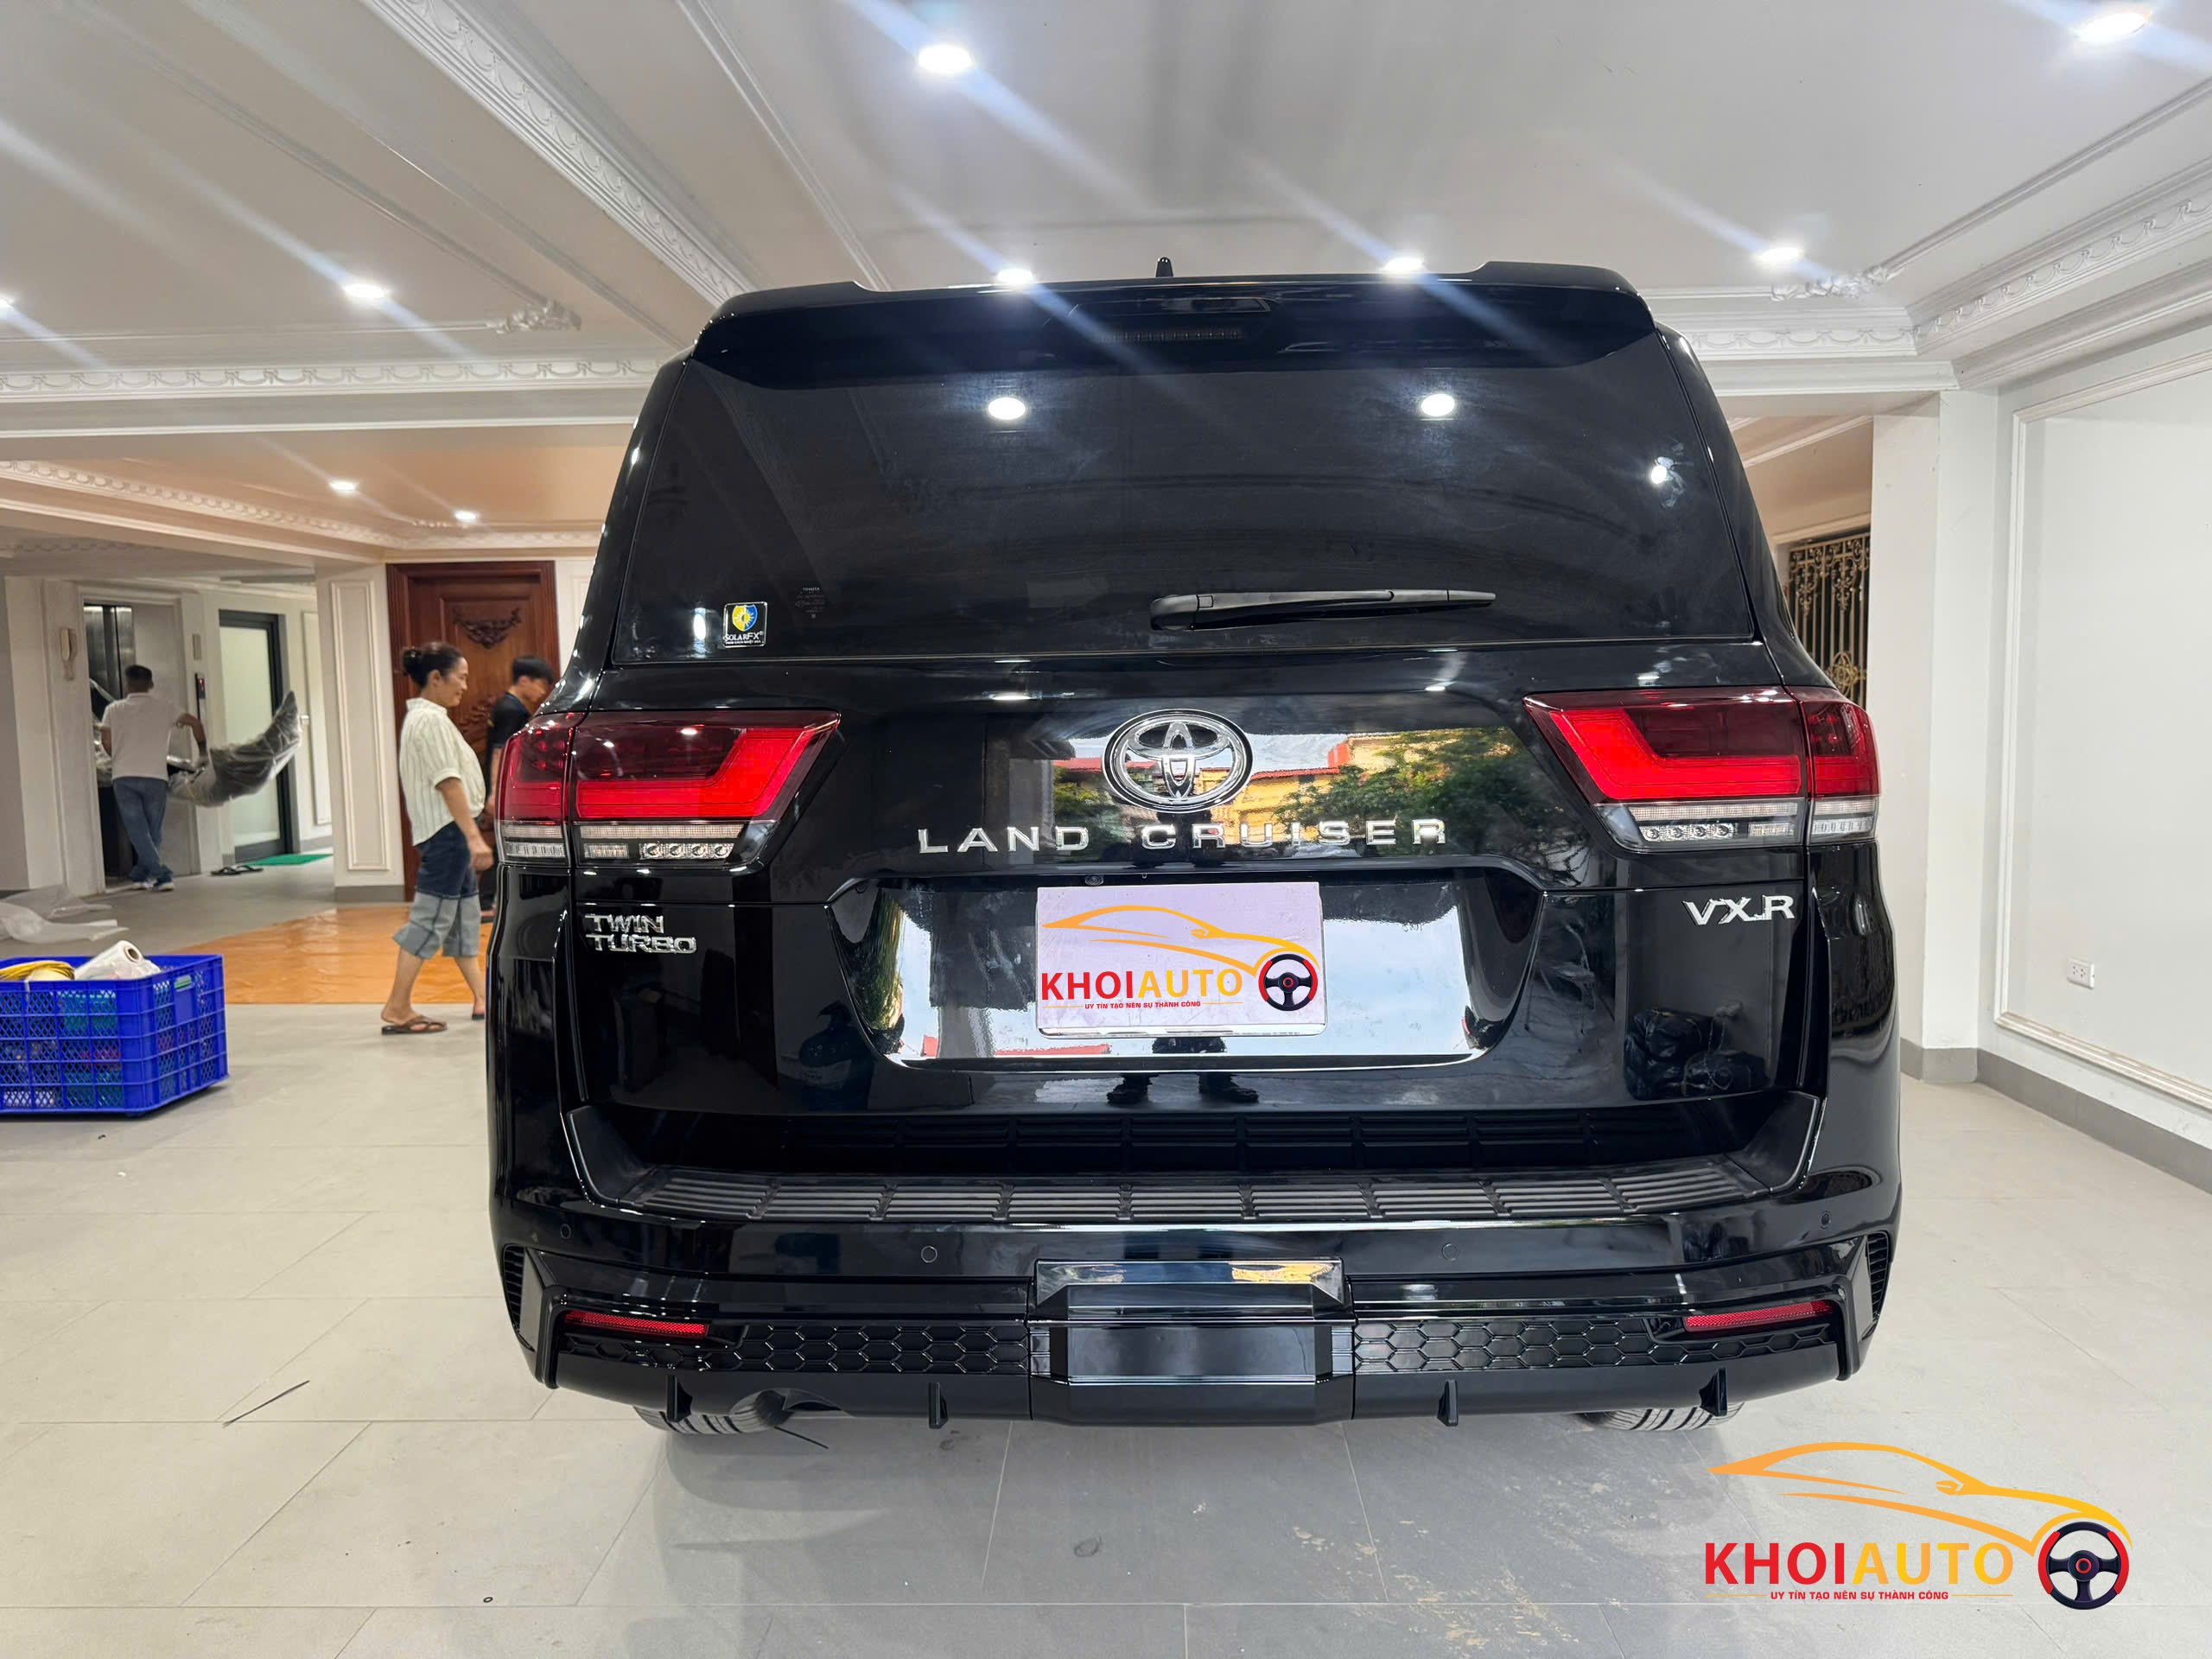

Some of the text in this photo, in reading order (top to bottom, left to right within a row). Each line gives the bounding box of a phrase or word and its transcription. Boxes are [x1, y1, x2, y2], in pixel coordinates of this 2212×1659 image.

[918, 818, 1446, 853] LAND CRUISER
[584, 913, 664, 934] TWIN
[585, 933, 697, 955] TURBO
